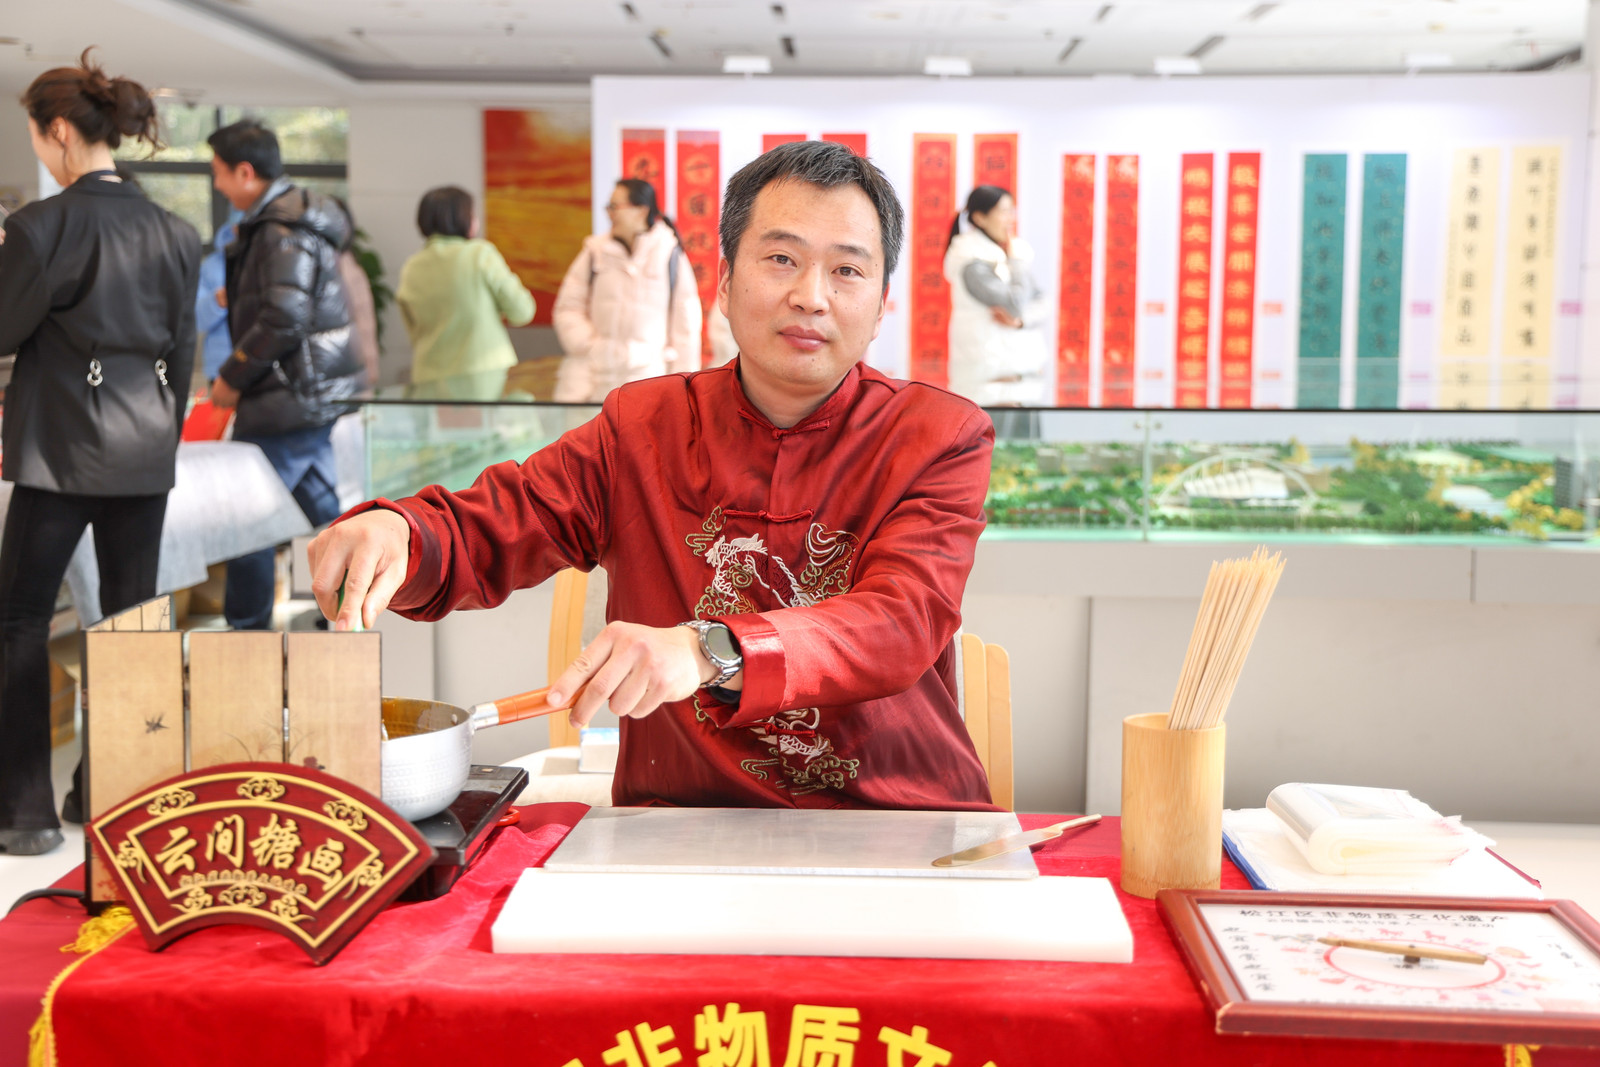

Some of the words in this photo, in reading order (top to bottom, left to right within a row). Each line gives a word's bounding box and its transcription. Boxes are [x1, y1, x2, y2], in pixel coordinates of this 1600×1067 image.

[155, 813, 345, 892] 云间糖画
[562, 1002, 995, 1067] 非物质文
